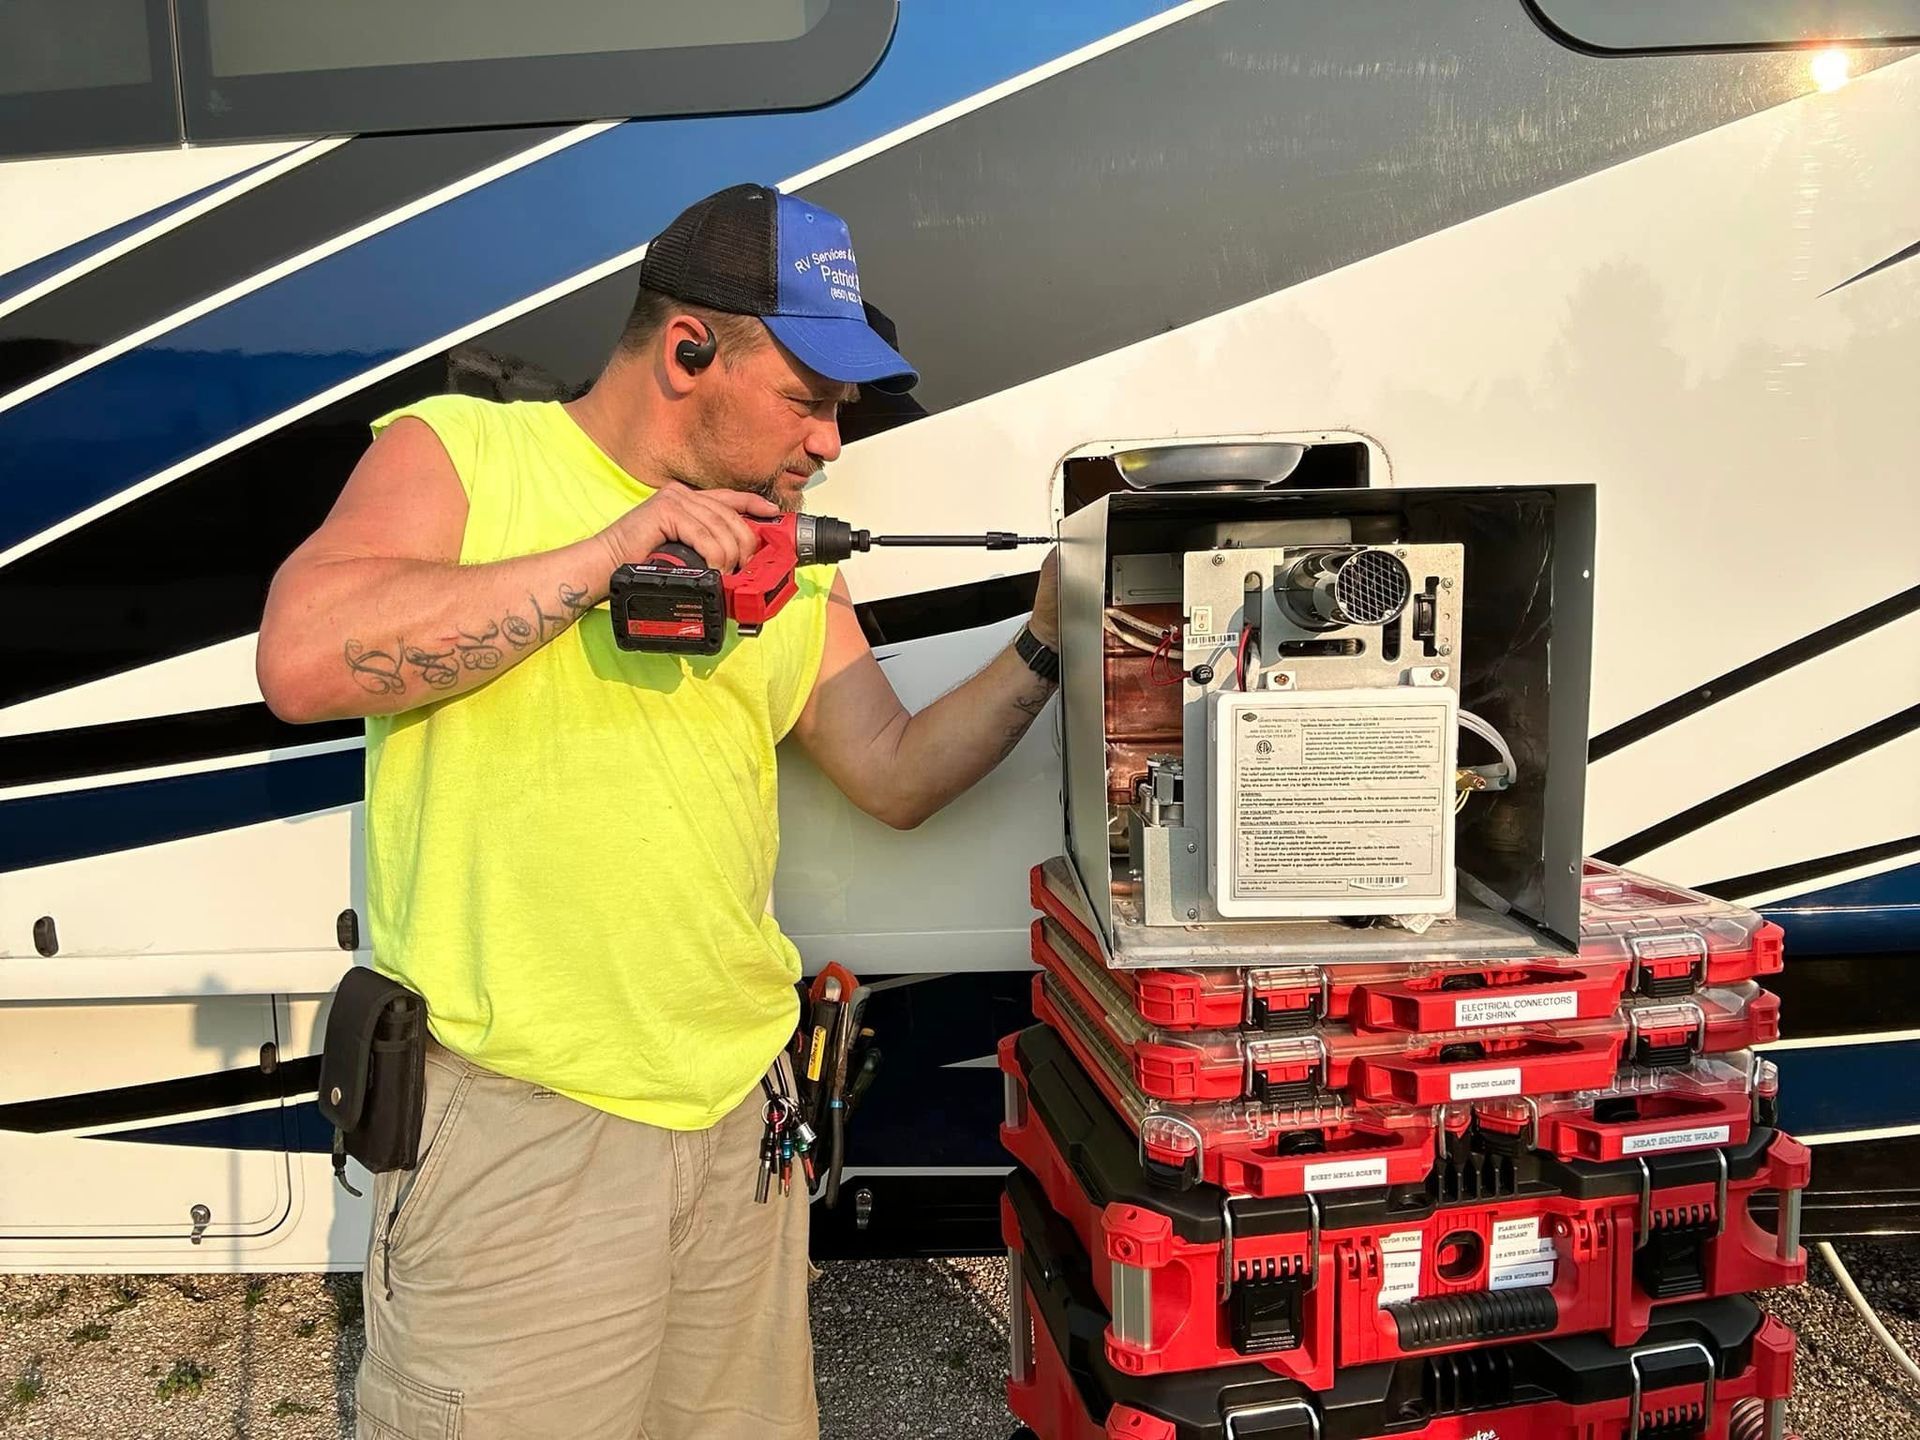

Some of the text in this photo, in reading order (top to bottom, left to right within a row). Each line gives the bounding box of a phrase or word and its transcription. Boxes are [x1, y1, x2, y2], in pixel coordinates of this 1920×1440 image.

[794, 255, 811, 274] RV
[811, 248, 847, 265] Services
[1461, 996, 1572, 1013] ELECTRICAL CONNECTORS
[1461, 1010, 1517, 1022] HEAT SHRINK
[1491, 1079, 1515, 1087] CLAMPS
[1632, 1131, 1719, 1148] HEAT SHRINK WRAP
[1310, 1169, 1382, 1181] SHEET METAL SCREWS
[1498, 1222, 1535, 1232] FLASH LIGHT
[1498, 1231, 1528, 1240] HEADLAMP
[1494, 1270, 1549, 1282] FLUKE MULTIMETER
